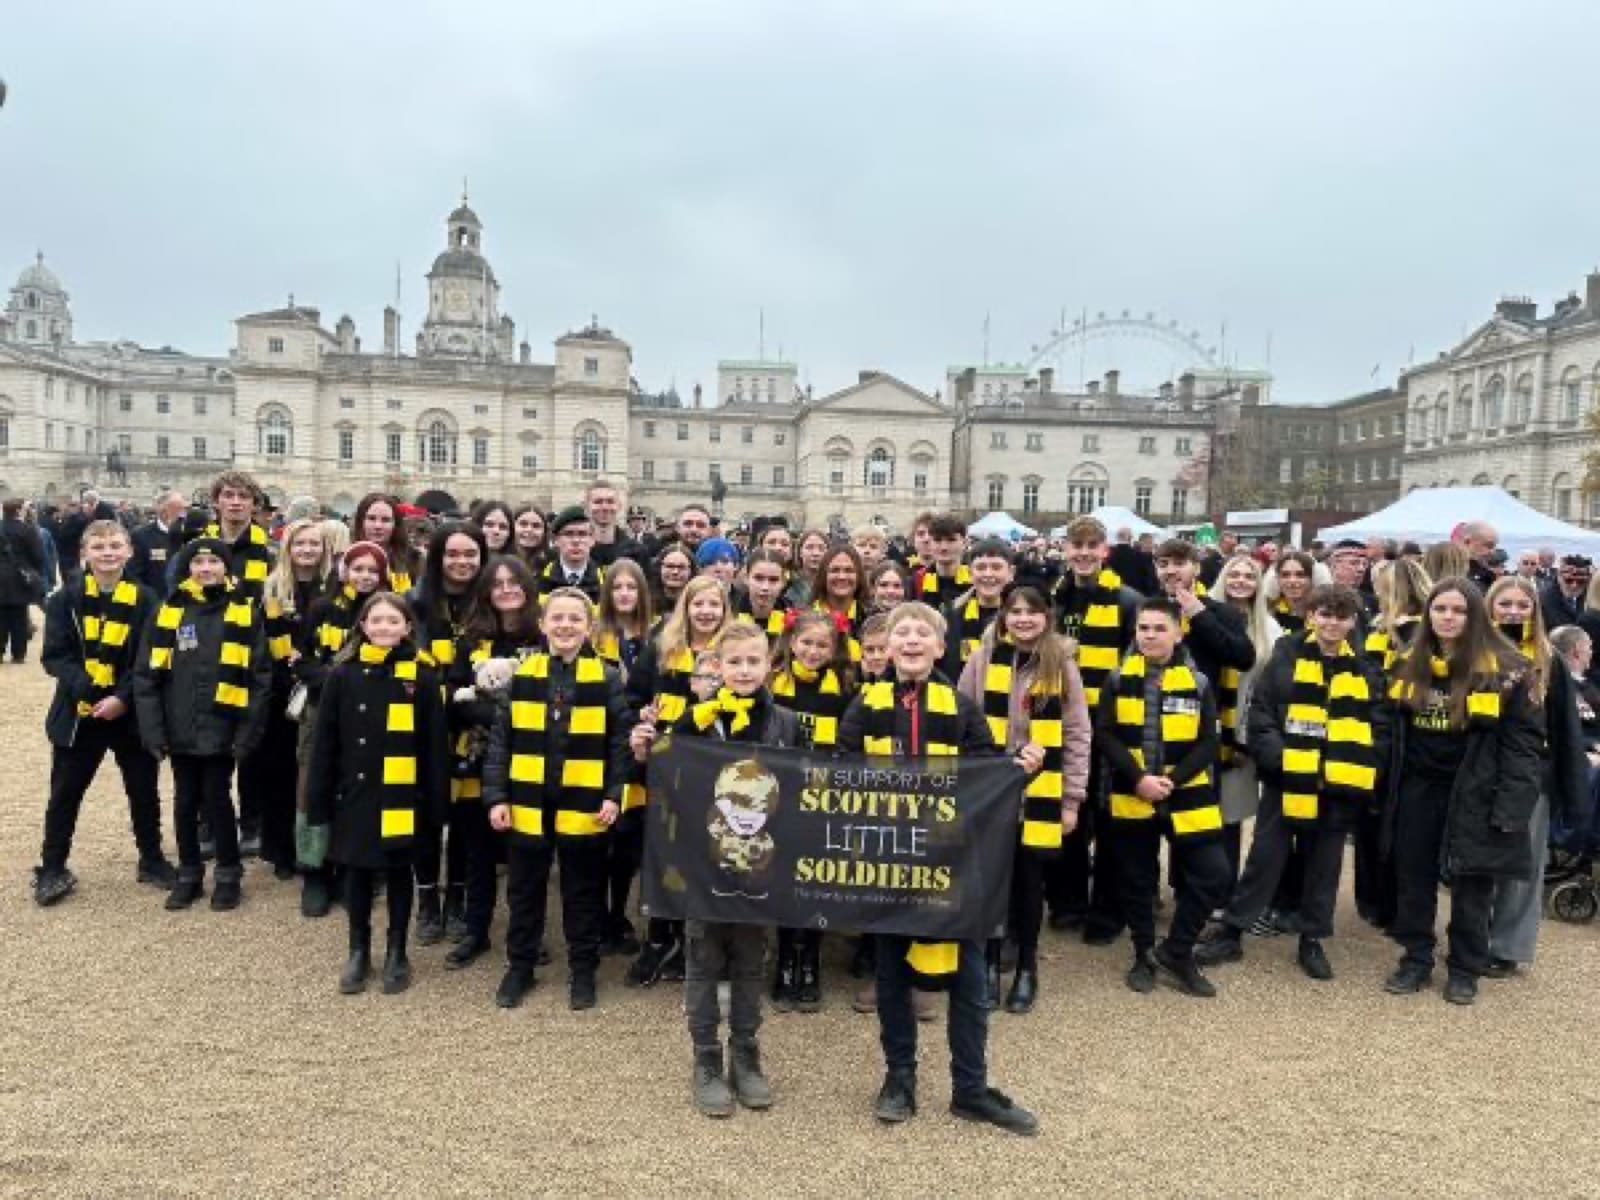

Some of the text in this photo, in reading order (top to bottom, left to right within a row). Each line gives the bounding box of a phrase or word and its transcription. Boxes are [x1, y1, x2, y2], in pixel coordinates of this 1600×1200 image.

[803, 767, 958, 789] IN SUPPORT OF
[800, 788, 956, 822] SCOTTY'S
[826, 820, 928, 857] LITTLE
[794, 857, 952, 891] SOLDIERS
